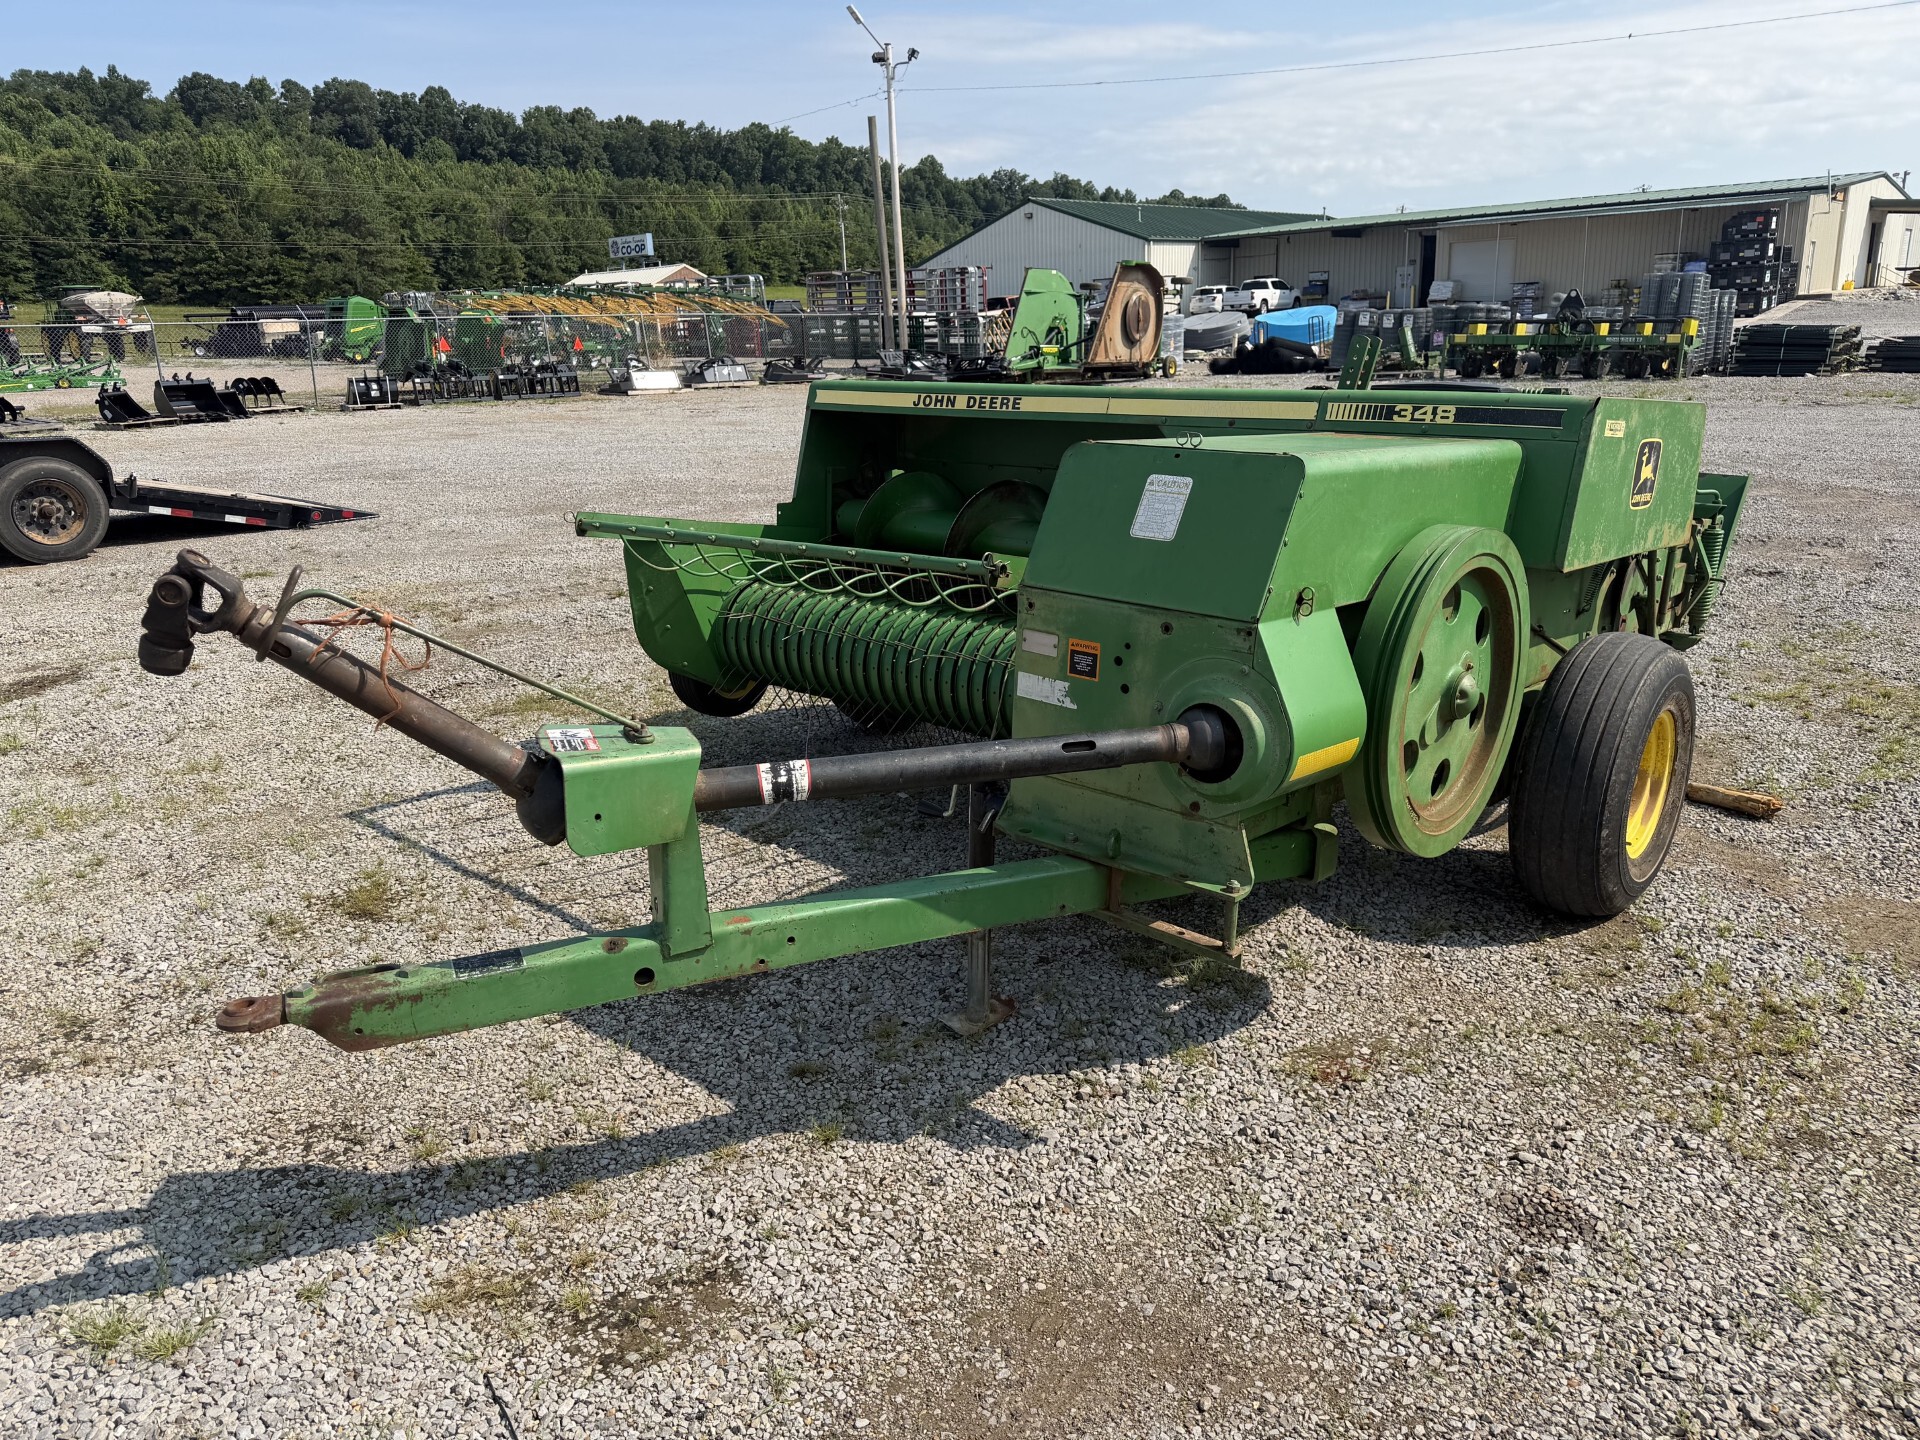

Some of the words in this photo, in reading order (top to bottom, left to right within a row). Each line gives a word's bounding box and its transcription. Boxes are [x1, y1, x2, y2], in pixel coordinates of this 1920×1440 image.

[621, 243, 646, 255] CO-OP
[912, 394, 957, 407] JOHN
[966, 395, 1022, 410] DEERE
[1392, 404, 1456, 424] 348
[1157, 480, 1190, 490] CAUTION
[1631, 494, 1641, 503] JOHN
[1640, 493, 1652, 502] DEERE
[1073, 642, 1098, 651] WARNING
